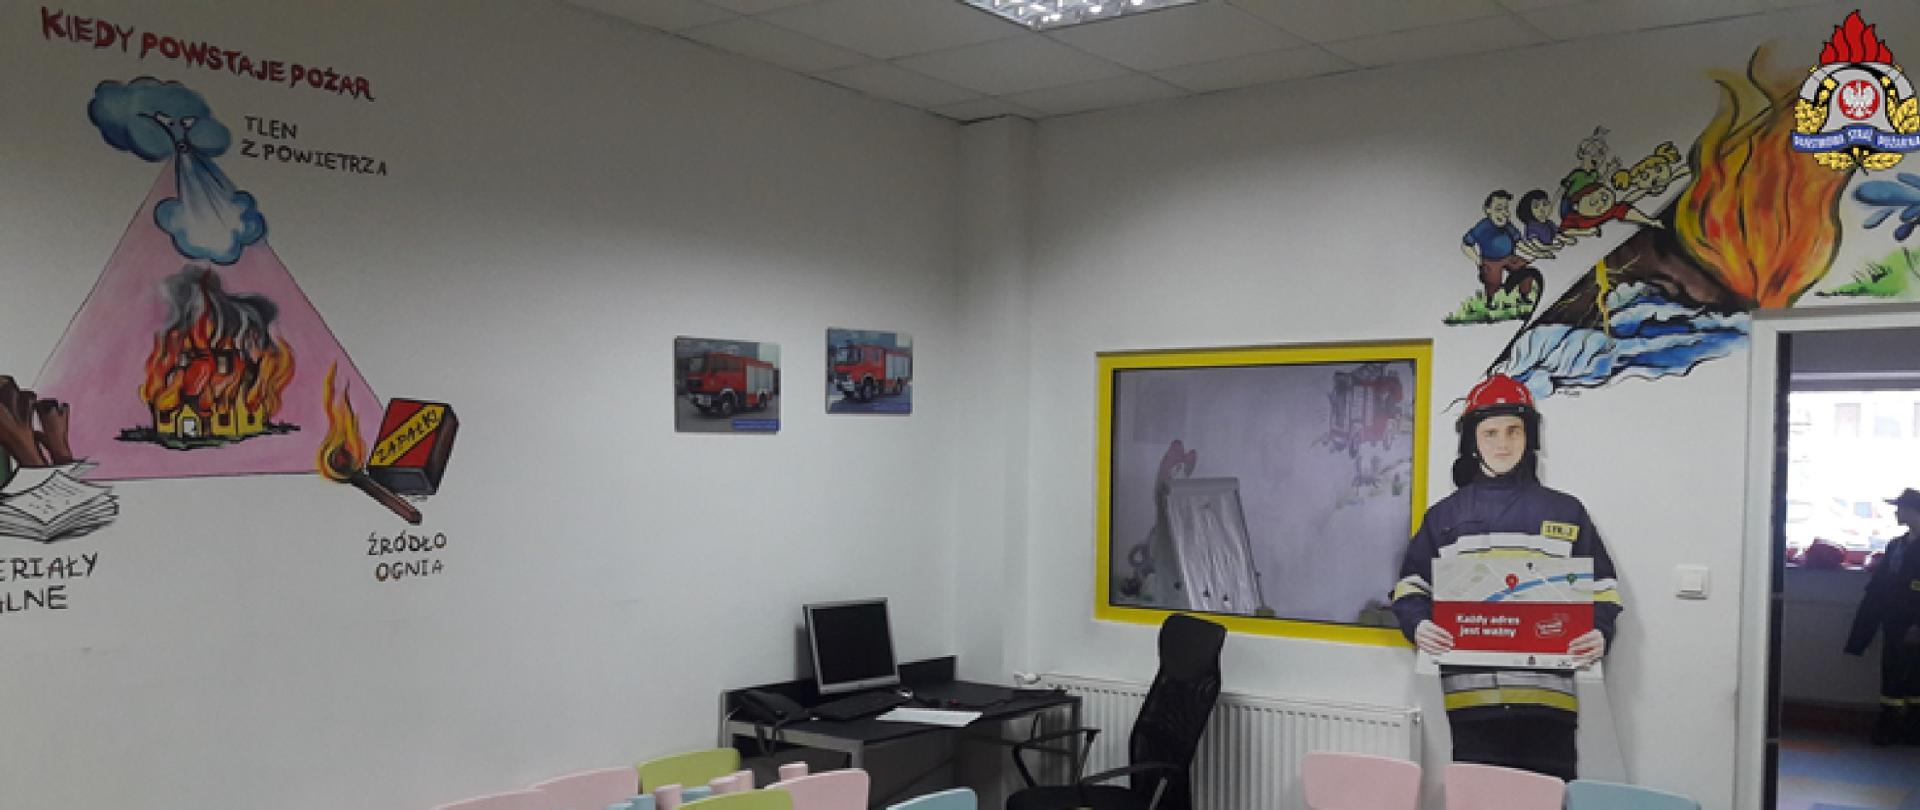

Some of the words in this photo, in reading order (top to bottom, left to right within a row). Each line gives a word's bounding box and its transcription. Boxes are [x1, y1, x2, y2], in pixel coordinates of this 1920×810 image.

[41, 7, 135, 53] KIEDY
[141, 32, 285, 83] POWSTAJE
[289, 66, 375, 102] POŻAR
[244, 115, 297, 140] TLEN
[264, 143, 388, 177] POWIETRZA
[376, 559, 444, 582] OGNIA
[0, 585, 69, 614] LNE
